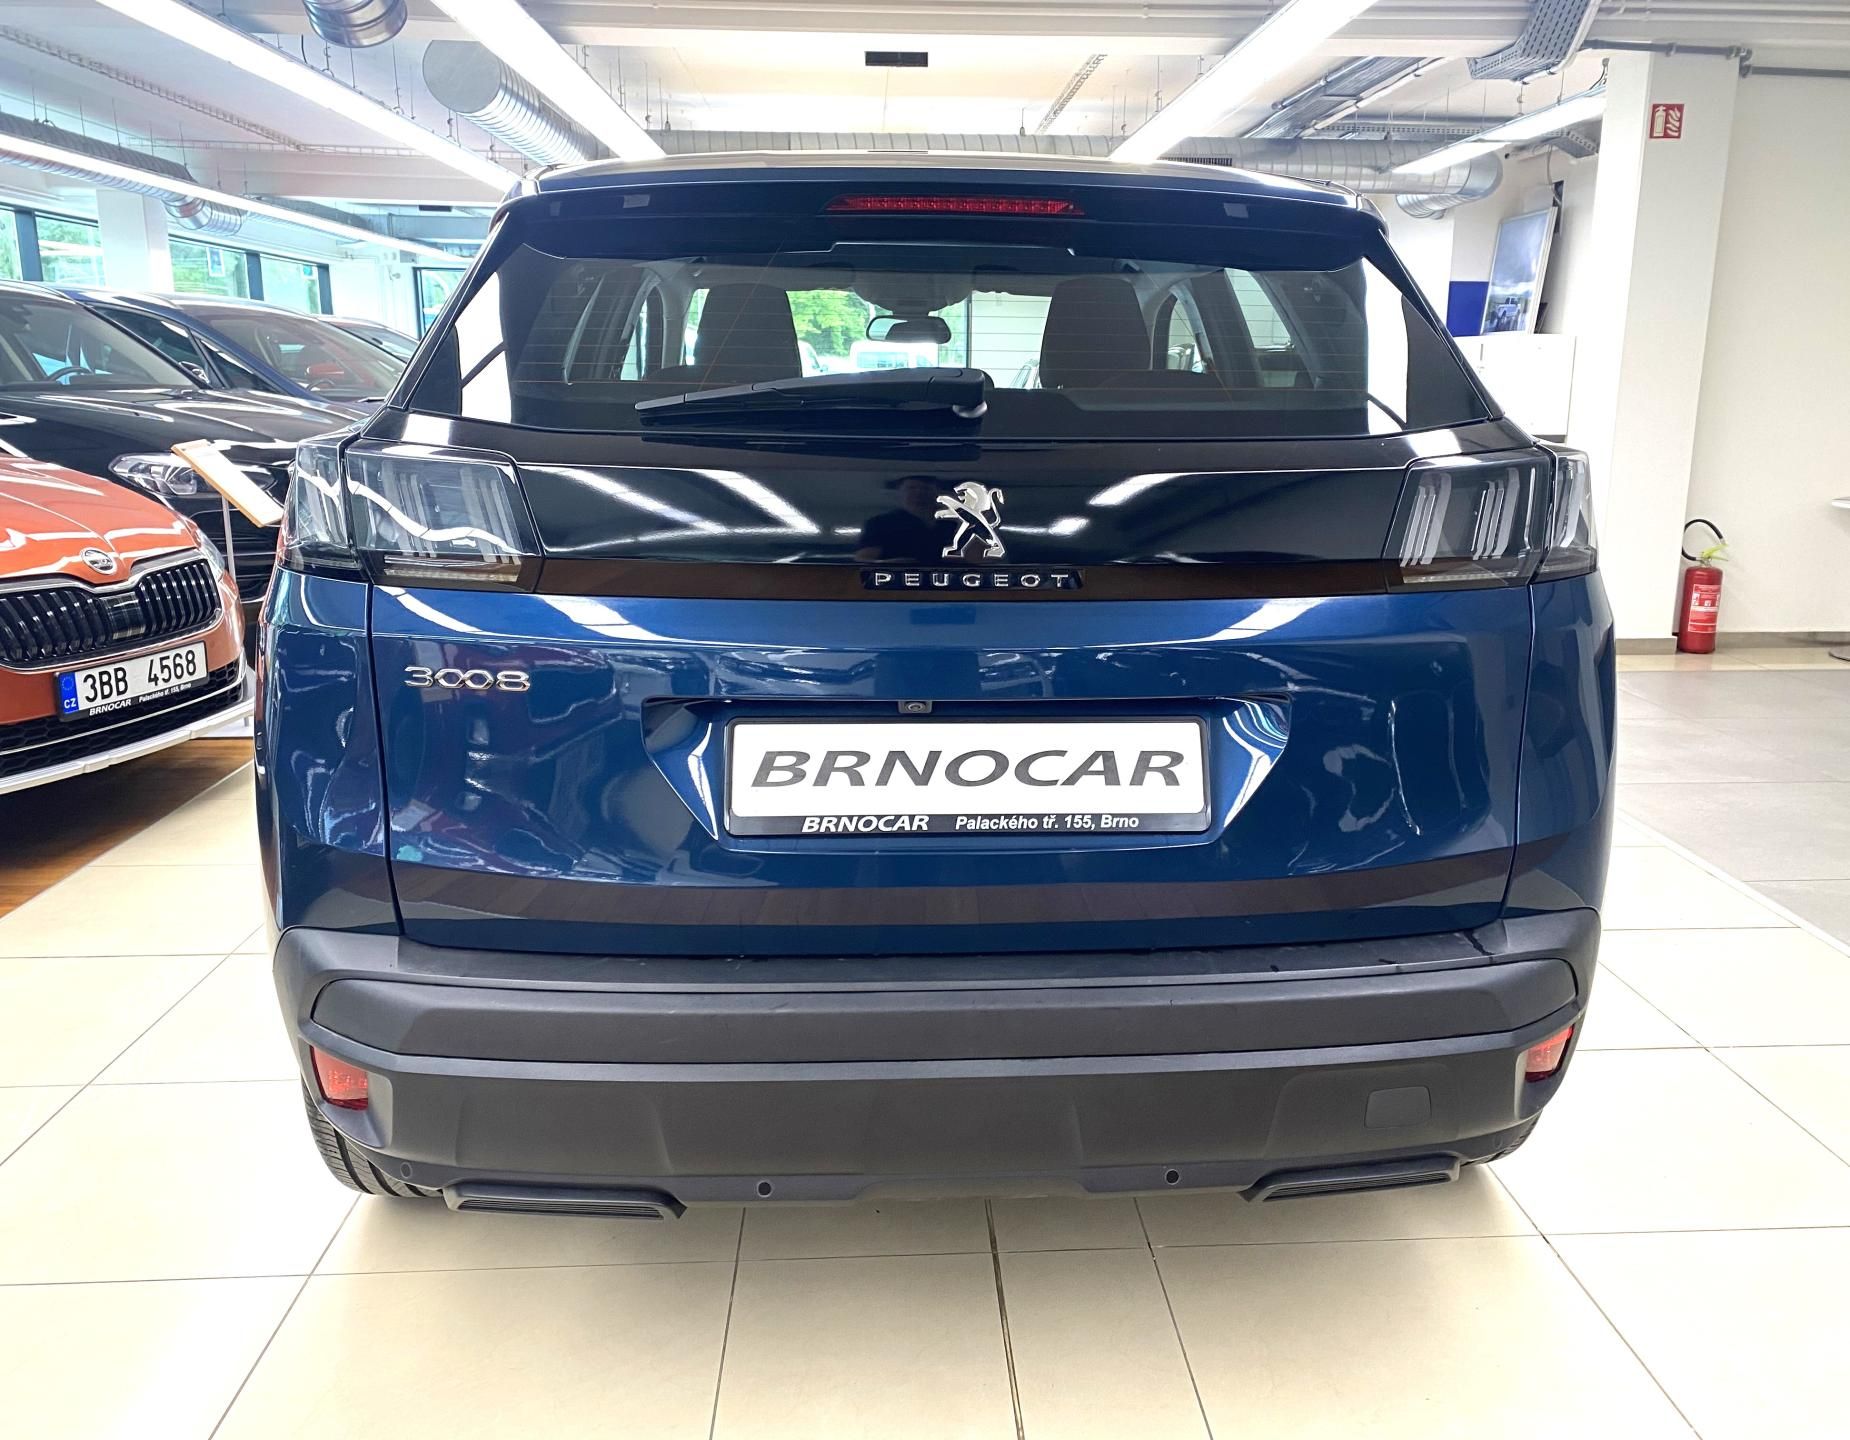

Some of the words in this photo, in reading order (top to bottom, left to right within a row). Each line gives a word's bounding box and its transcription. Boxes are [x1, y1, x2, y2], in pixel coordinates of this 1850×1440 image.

[875, 572, 1069, 588] PEUGEOT
[83, 666, 129, 703] 3BB
[147, 650, 197, 687] 4568
[404, 666, 531, 691] 3008
[63, 698, 77, 709] CZ
[89, 699, 132, 716] BRNOCAR
[751, 749, 1185, 788] BRNOCAR
[801, 815, 930, 833] BRNOCAR
[955, 815, 1039, 830] Palackého
[1043, 815, 1059, 829] tř.
[1064, 815, 1096, 831] 155,
[1100, 814, 1140, 829] Brno
